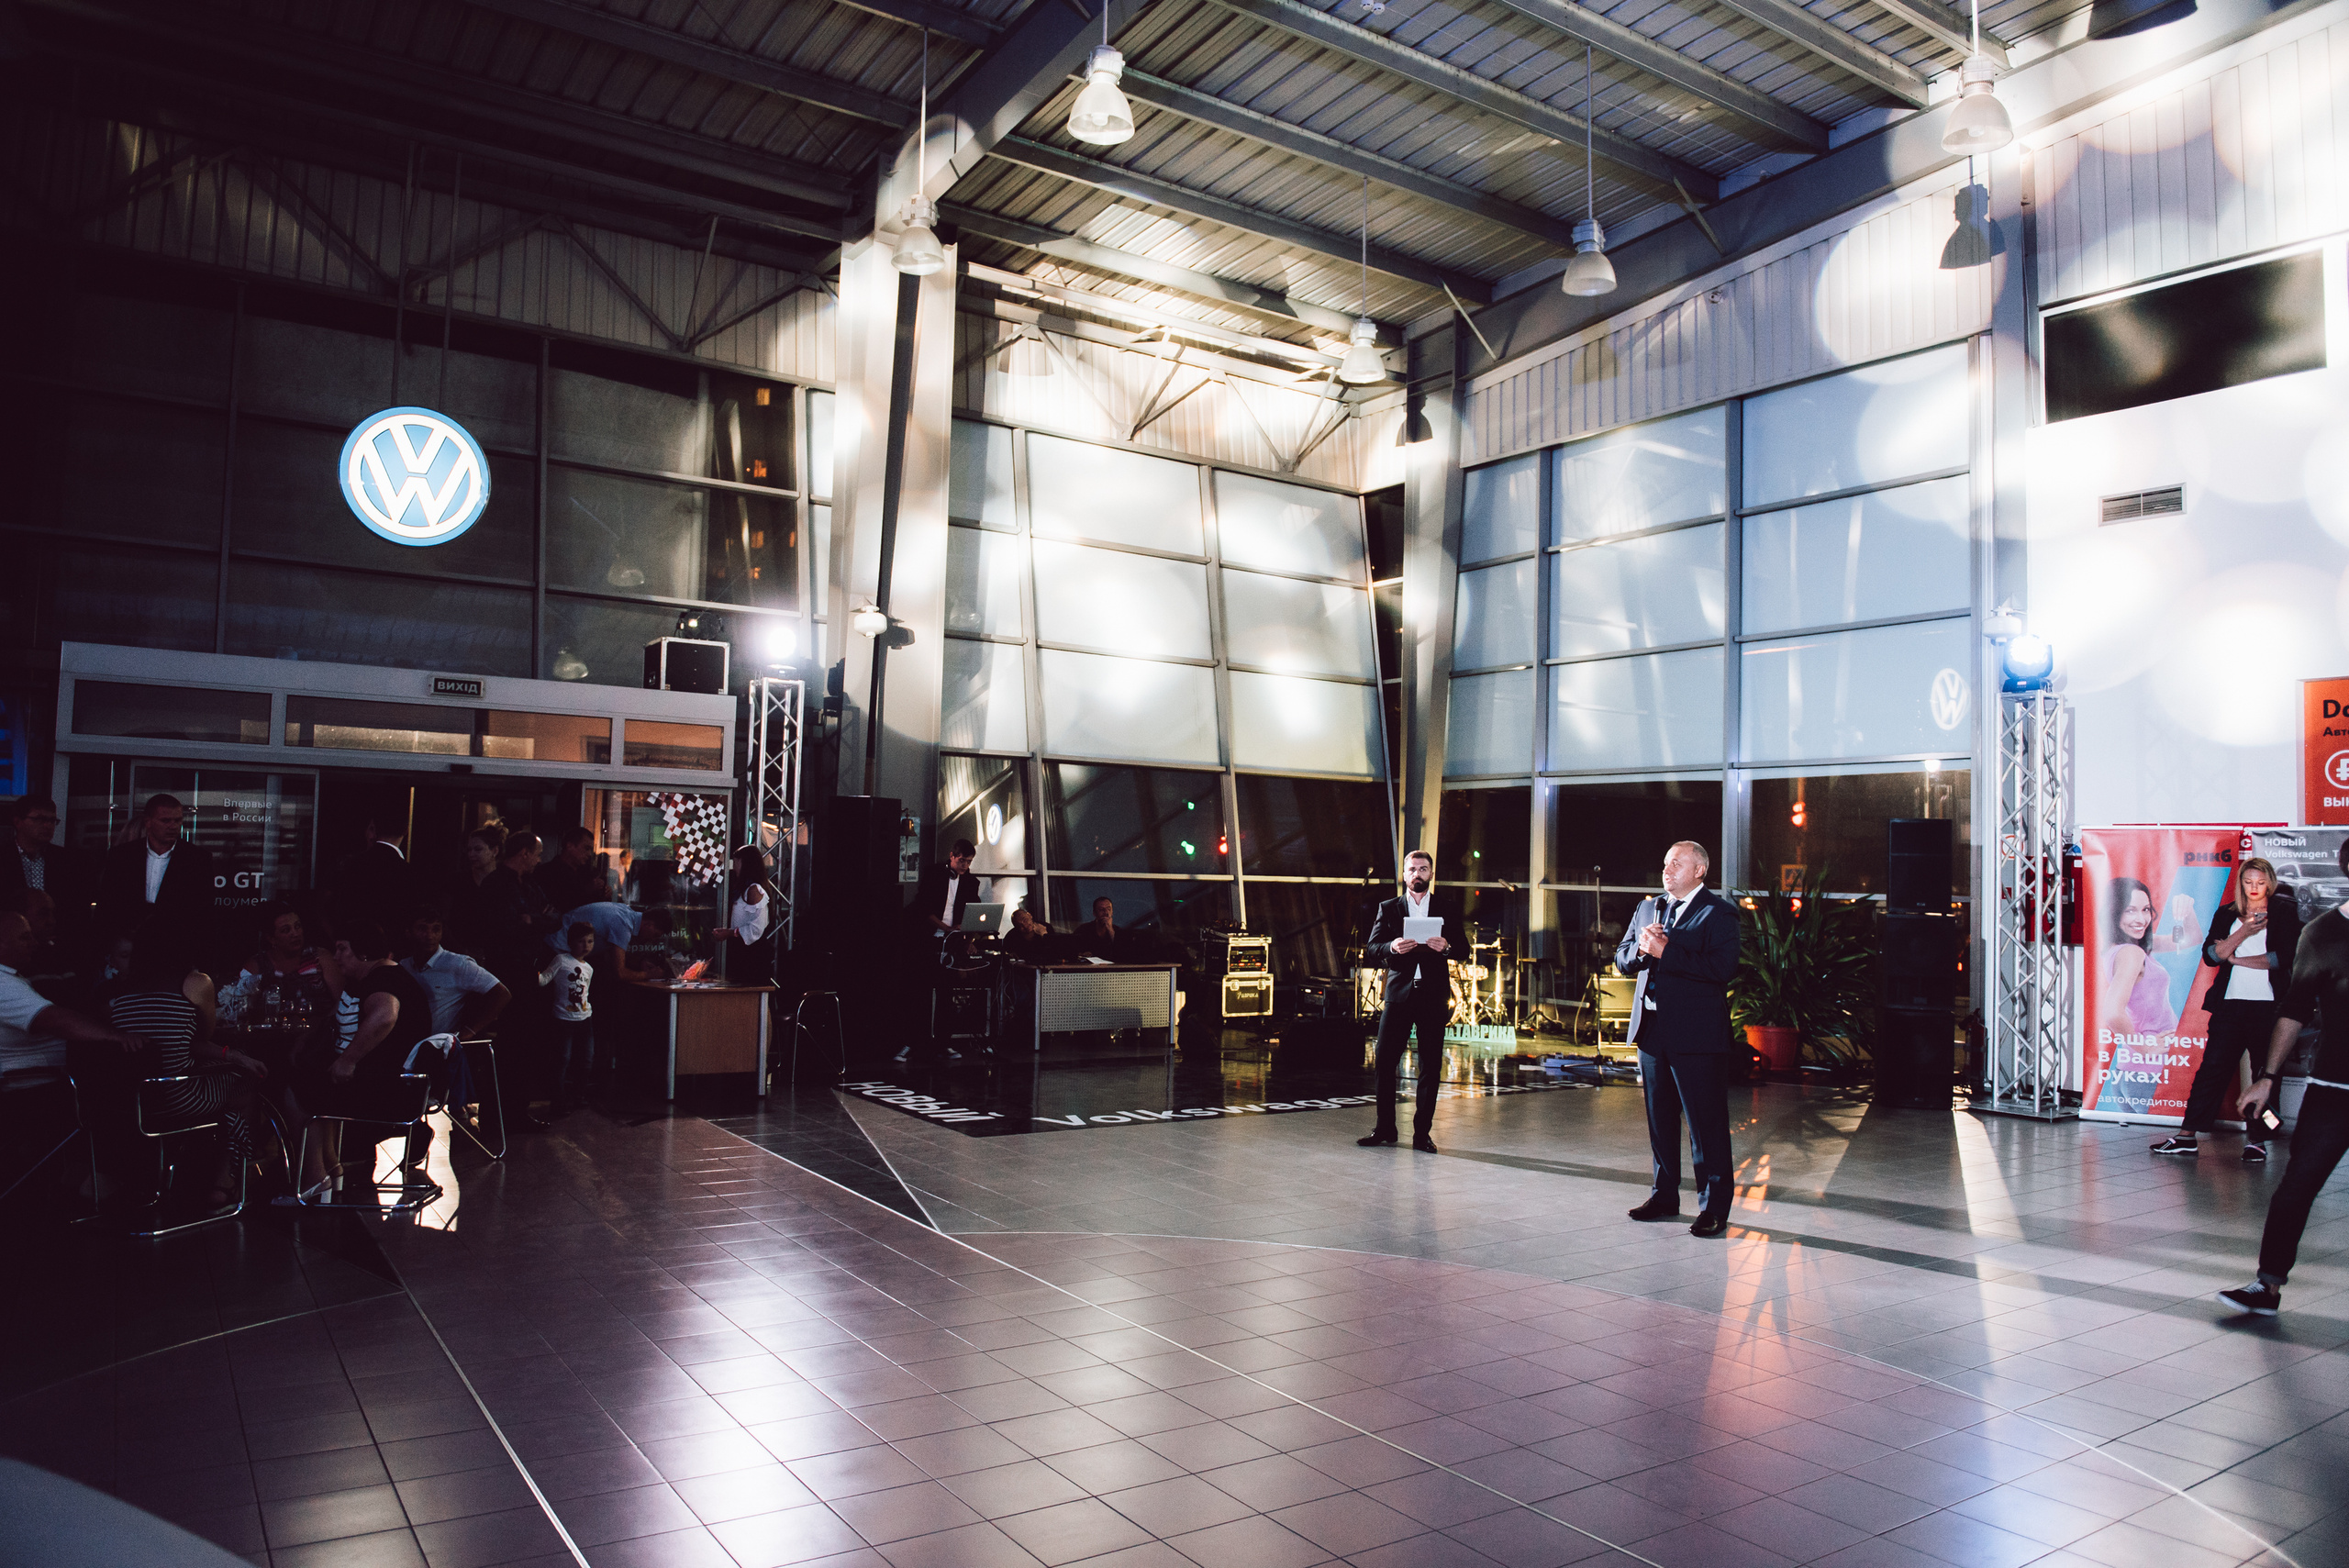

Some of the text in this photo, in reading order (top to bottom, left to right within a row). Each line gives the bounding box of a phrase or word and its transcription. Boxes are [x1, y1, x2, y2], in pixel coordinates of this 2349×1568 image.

[437, 681, 478, 695] ВИХІД
[223, 797, 273, 810] Впервые
[232, 812, 272, 823] России
[2264, 836, 2307, 847] НОВЫЙ
[2183, 849, 2232, 865] рнкб
[2264, 850, 2328, 860] Volkswagen
[233, 871, 265, 889] GT
[2098, 1029, 2209, 1050] Ваша меч
[2098, 1048, 2191, 1067] в Ваших
[2098, 1068, 2169, 1084] руках!
[838, 1081, 1006, 1123] НОВЫЙ
